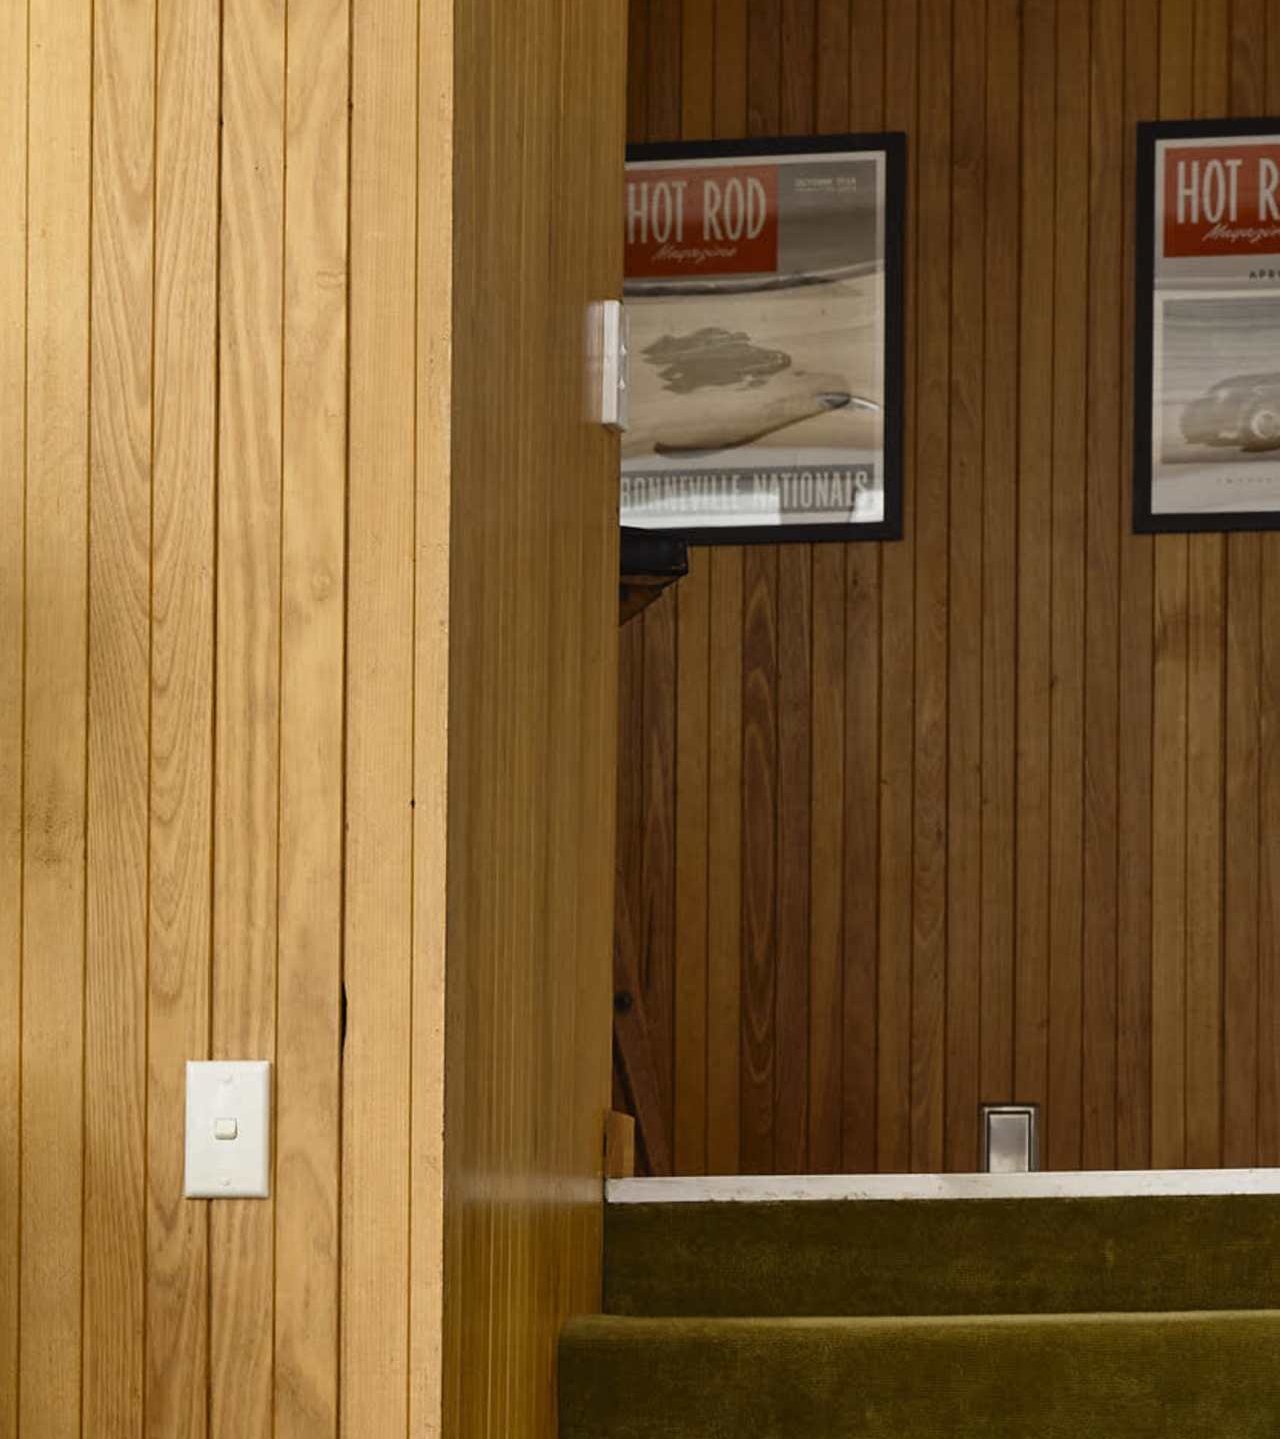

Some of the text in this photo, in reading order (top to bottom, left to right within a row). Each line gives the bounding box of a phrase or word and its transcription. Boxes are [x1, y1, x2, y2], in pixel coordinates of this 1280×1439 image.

[627, 177, 767, 244] HOT ROD
[1177, 159, 1242, 224] HOT
[652, 243, 737, 264] Magazine
[753, 471, 869, 511] NATIONALS
